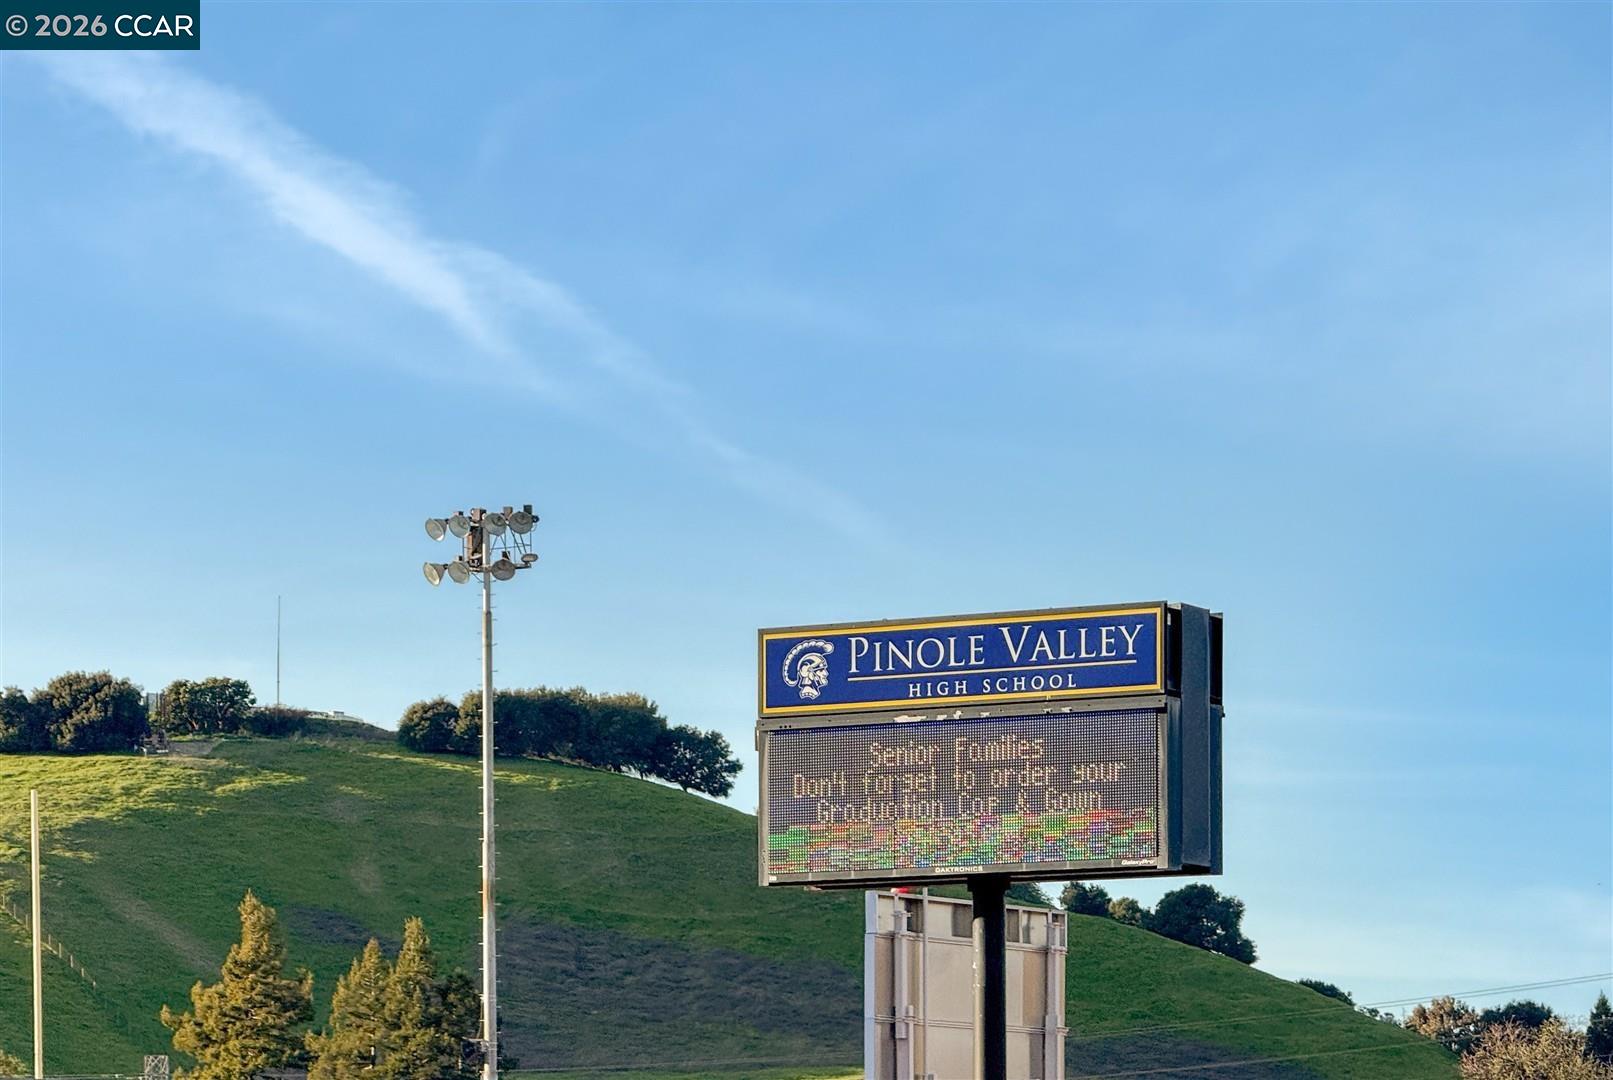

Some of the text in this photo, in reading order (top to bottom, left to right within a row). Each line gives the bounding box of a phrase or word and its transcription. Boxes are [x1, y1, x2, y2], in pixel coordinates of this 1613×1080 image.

[847, 624, 1144, 674] PINOLE VALLEY
[908, 673, 1077, 698] HIGH SCHOOL
[869, 734, 1045, 768] Senior Families
[862, 765, 937, 796] forget
[953, 758, 976, 790] to
[990, 761, 1057, 789] order
[1072, 761, 1127, 784] your
[816, 796, 943, 825] Graduation
[1045, 788, 1103, 813] Gown
